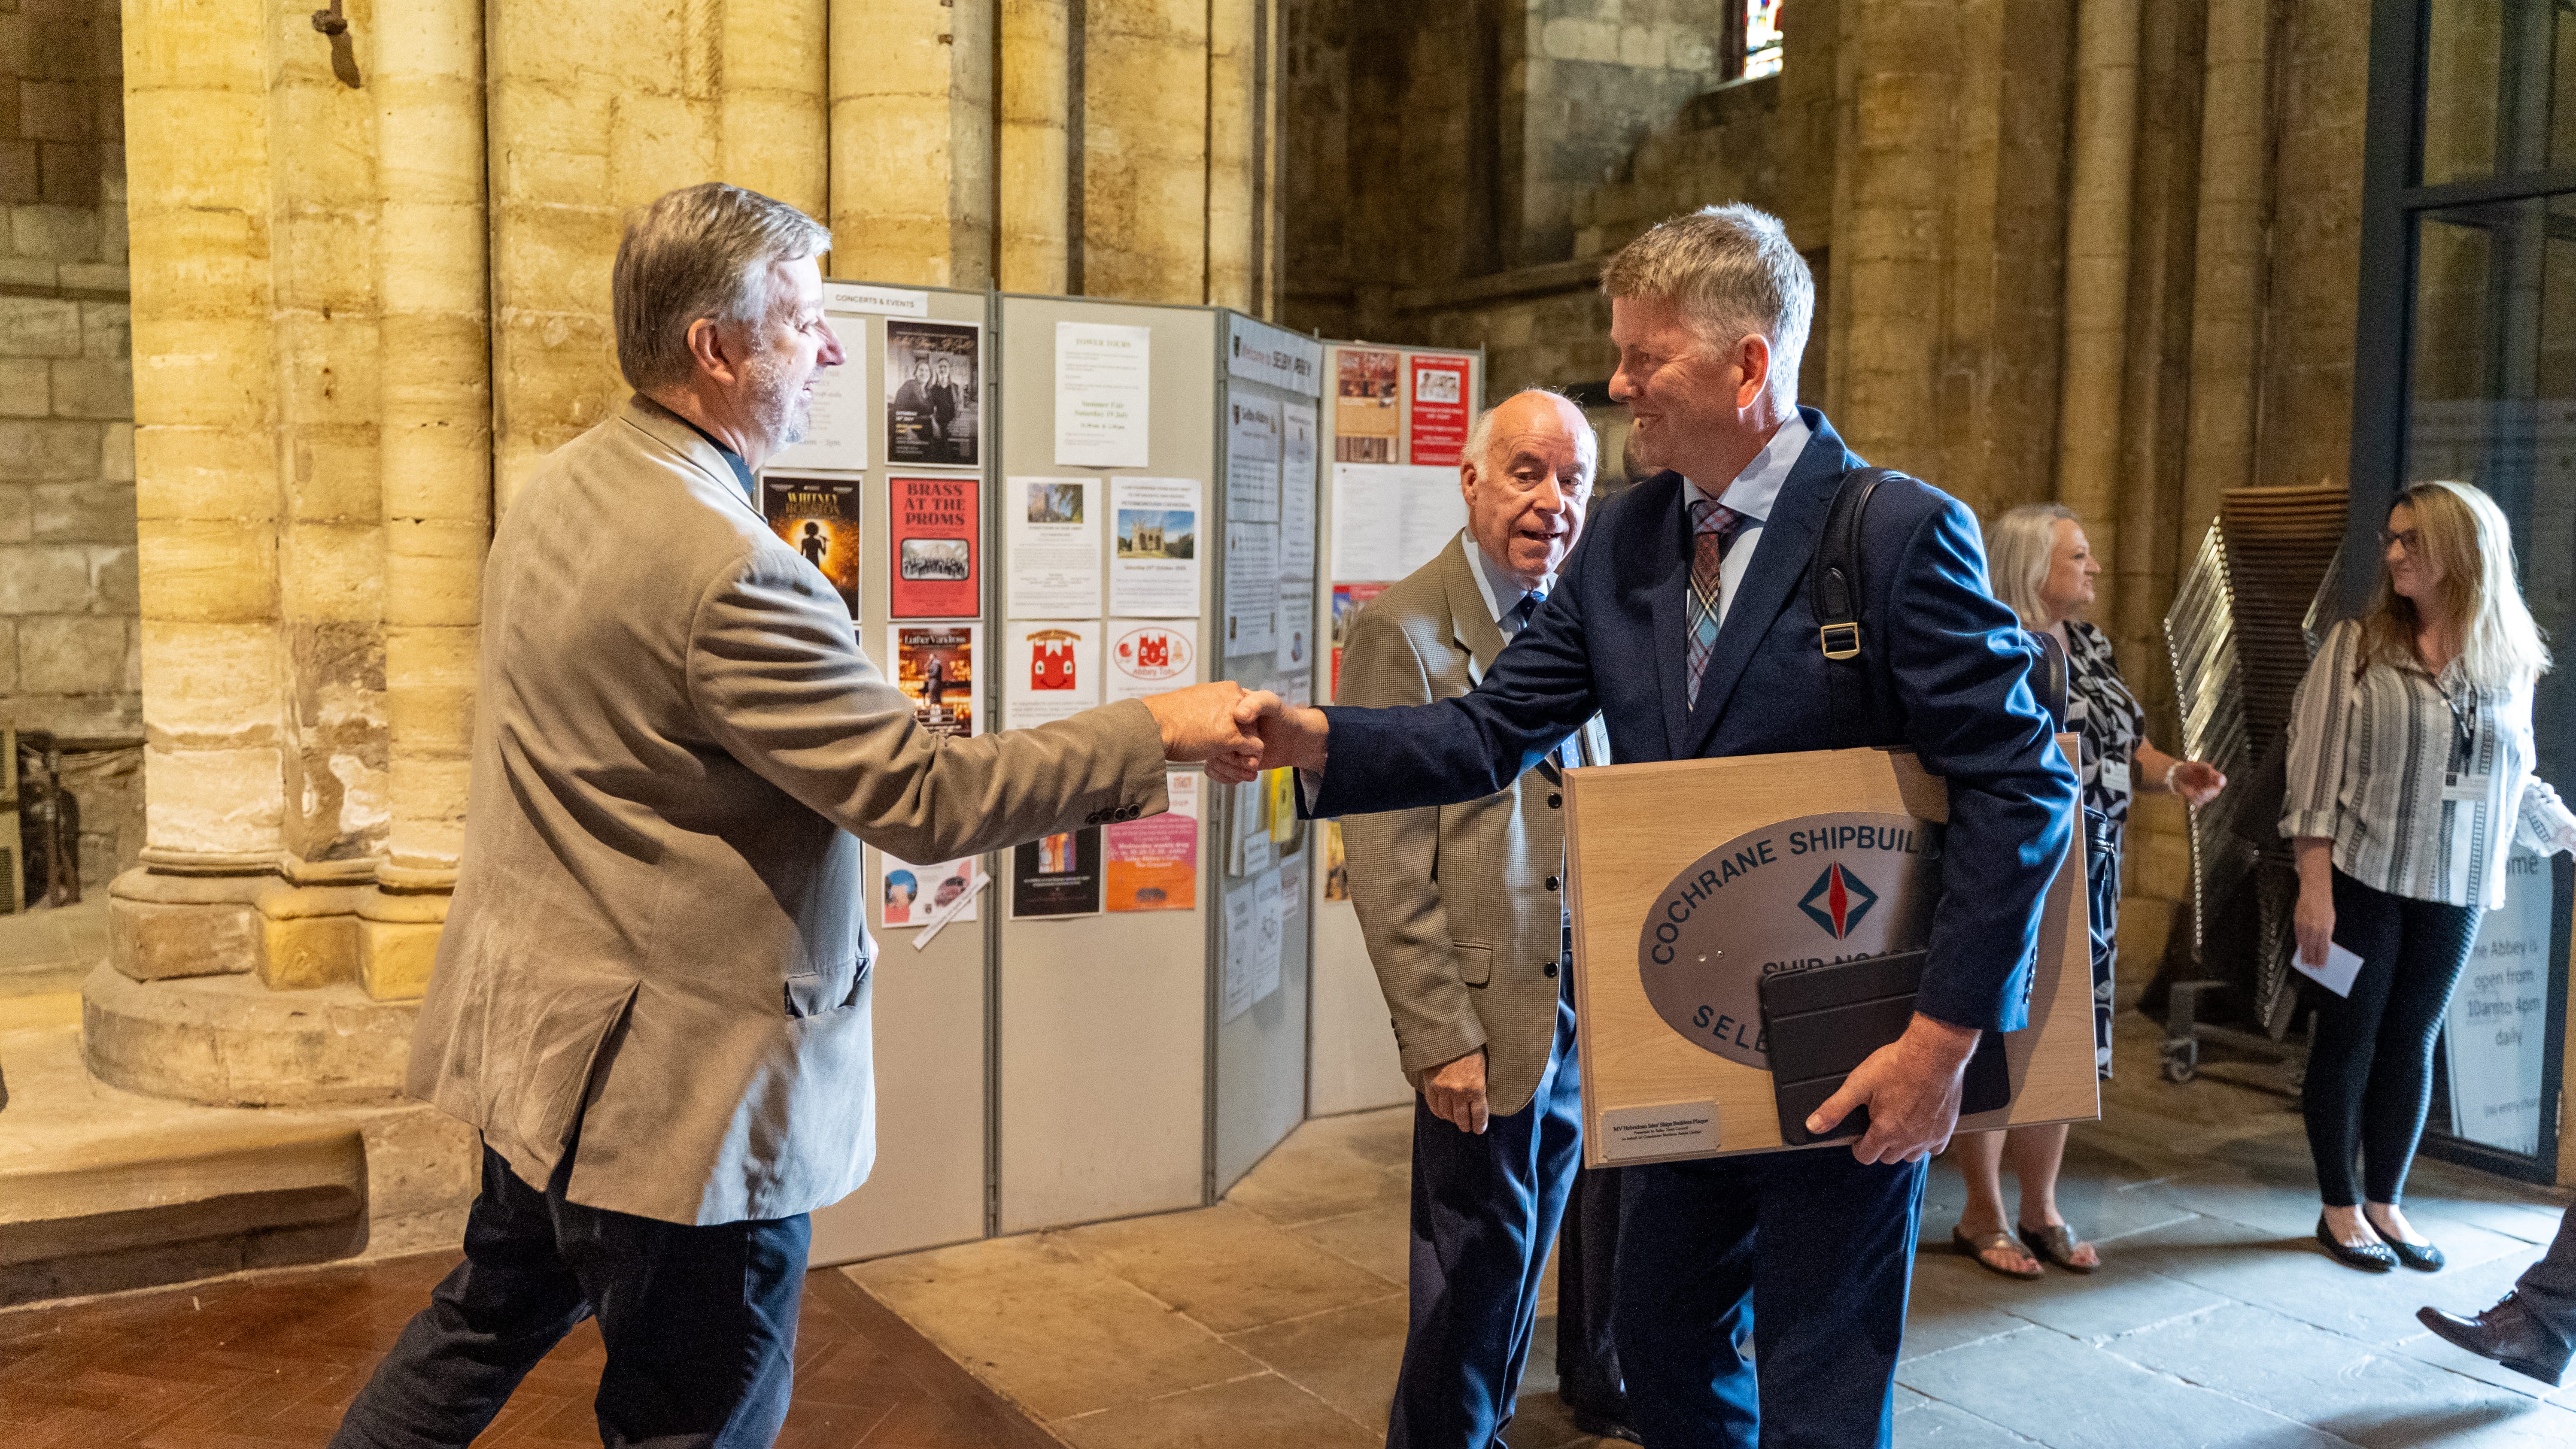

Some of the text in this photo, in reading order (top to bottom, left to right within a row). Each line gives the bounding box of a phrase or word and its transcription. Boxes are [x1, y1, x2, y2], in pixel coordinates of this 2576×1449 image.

[835, 294, 877, 304] CONCERTS
[886, 299, 915, 308] EVENTS
[907, 483, 963, 496] BRASS
[787, 492, 838, 504] WHITNEY
[904, 497, 966, 511] AT THE
[905, 512, 965, 526] PROMS
[1651, 825, 1919, 965] COCHRANE SHIPBUIL
[2491, 940, 2526, 958] Abbey
[2474, 968, 2534, 993] open from
[1692, 1005, 1769, 1053] SELB
[2495, 1028, 2523, 1047] daily
